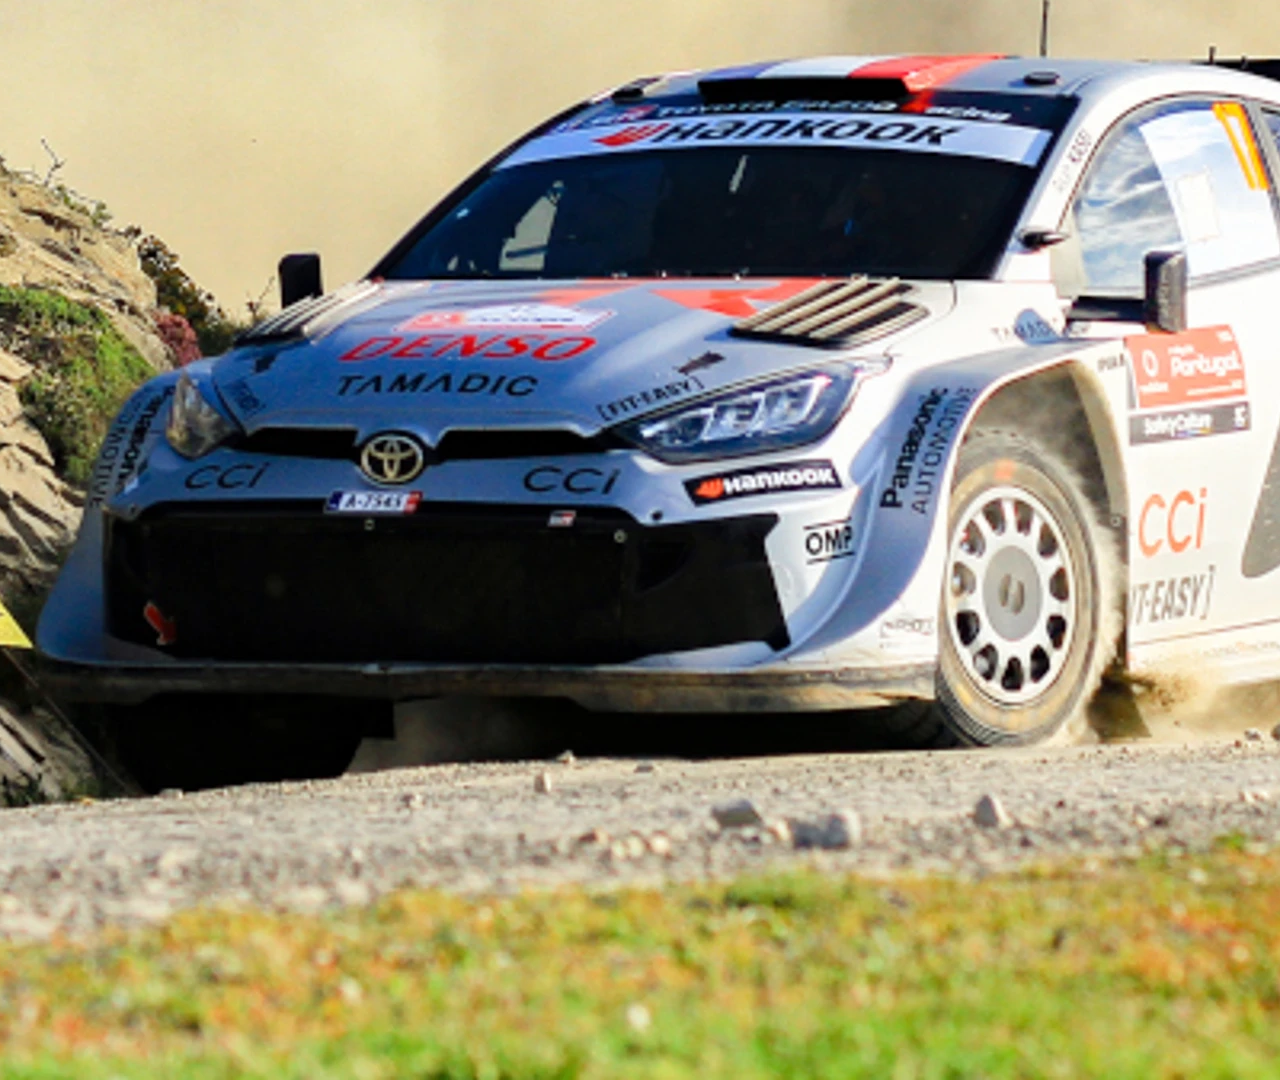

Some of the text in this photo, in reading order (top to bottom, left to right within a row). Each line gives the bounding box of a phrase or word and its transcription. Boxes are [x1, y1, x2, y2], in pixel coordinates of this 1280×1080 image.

[340, 334, 597, 362] DENSO
[335, 372, 539, 397] TAMADIC
[879, 388, 948, 508] Panasonic
[911, 388, 977, 515] AUTOMOTIVE
[805, 525, 855, 556] OMP
